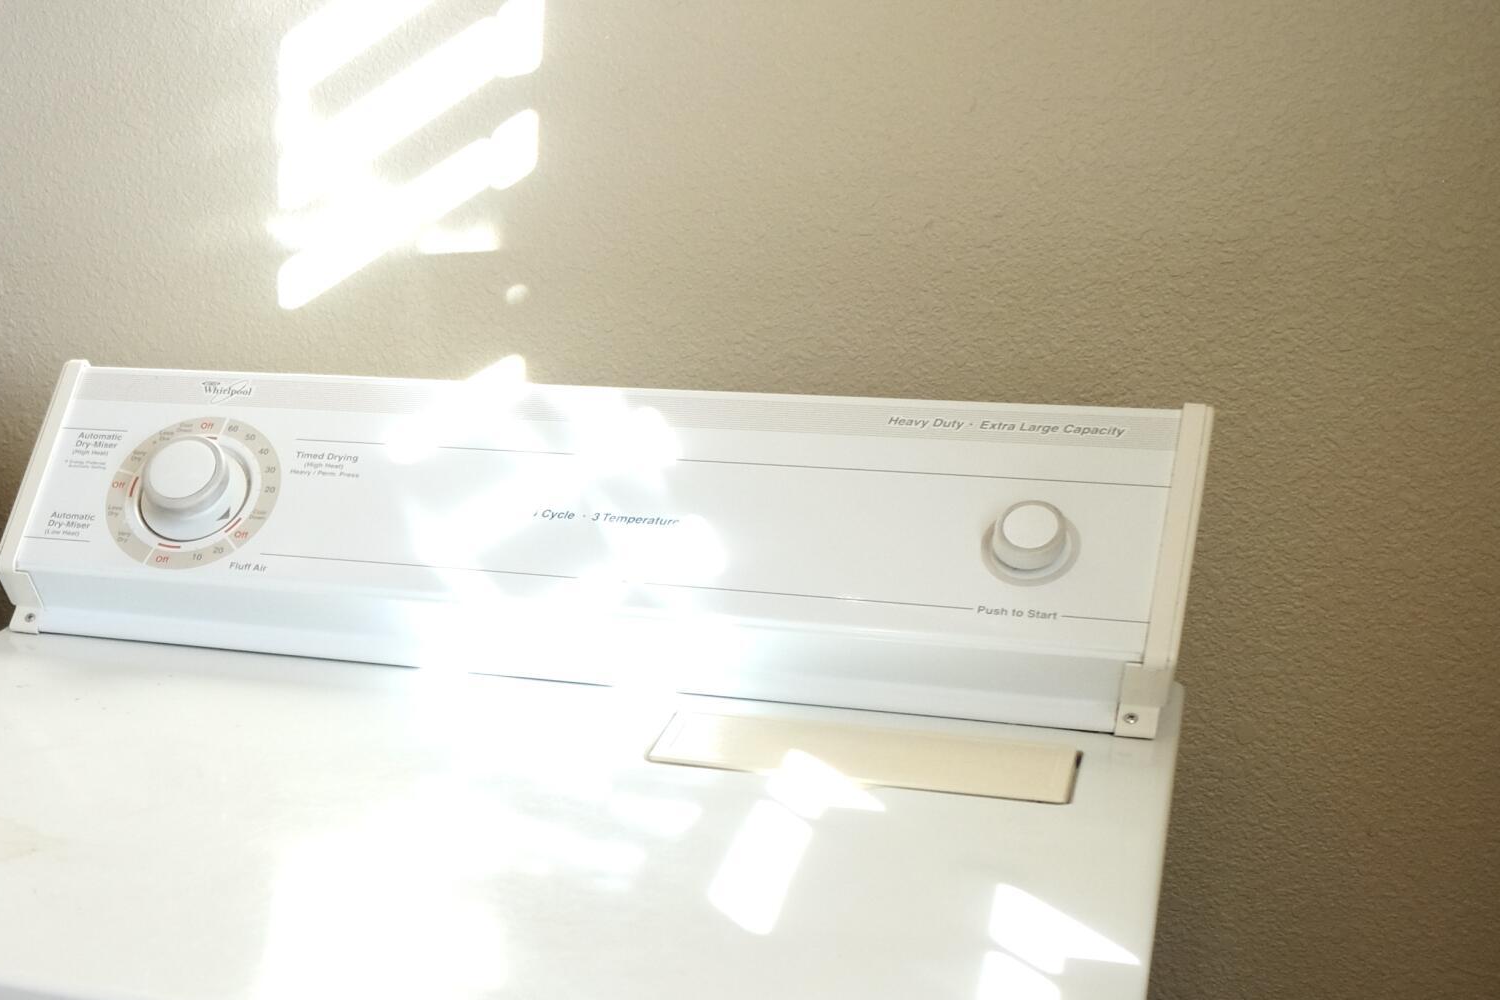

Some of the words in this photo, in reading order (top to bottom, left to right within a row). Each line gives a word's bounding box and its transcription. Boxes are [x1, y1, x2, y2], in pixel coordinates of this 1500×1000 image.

[202, 381, 252, 399] Whirlpool
[200, 422, 215, 430] Off
[228, 425, 240, 433] 60
[888, 416, 929, 429] Heavy
[932, 418, 965, 431] Duty
[980, 420, 1016, 432] Extra
[1019, 422, 1060, 435] Large
[1063, 424, 1126, 438] Capacity
[78, 431, 122, 441] Automatic
[245, 433, 256, 441] 50
[75, 440, 118, 449] Dry-Miser
[258, 448, 270, 456] 40
[297, 451, 325, 460] Timed
[327, 452, 359, 464] Drying
[264, 466, 276, 474] 30
[112, 481, 126, 489] Off
[264, 485, 276, 493] 20
[50, 511, 96, 521] Automatic
[541, 509, 576, 521] Cycle
[591, 513, 601, 521] 3
[47, 519, 91, 529] Dry-Miser
[234, 530, 248, 539] Off
[213, 546, 224, 554] 20
[155, 555, 170, 563] Off
[192, 552, 203, 561] 10
[229, 561, 251, 570] Fluff
[255, 563, 268, 572] Air
[977, 605, 1009, 616] Push
[1011, 608, 1024, 617] to
[1027, 609, 1058, 620] Start
